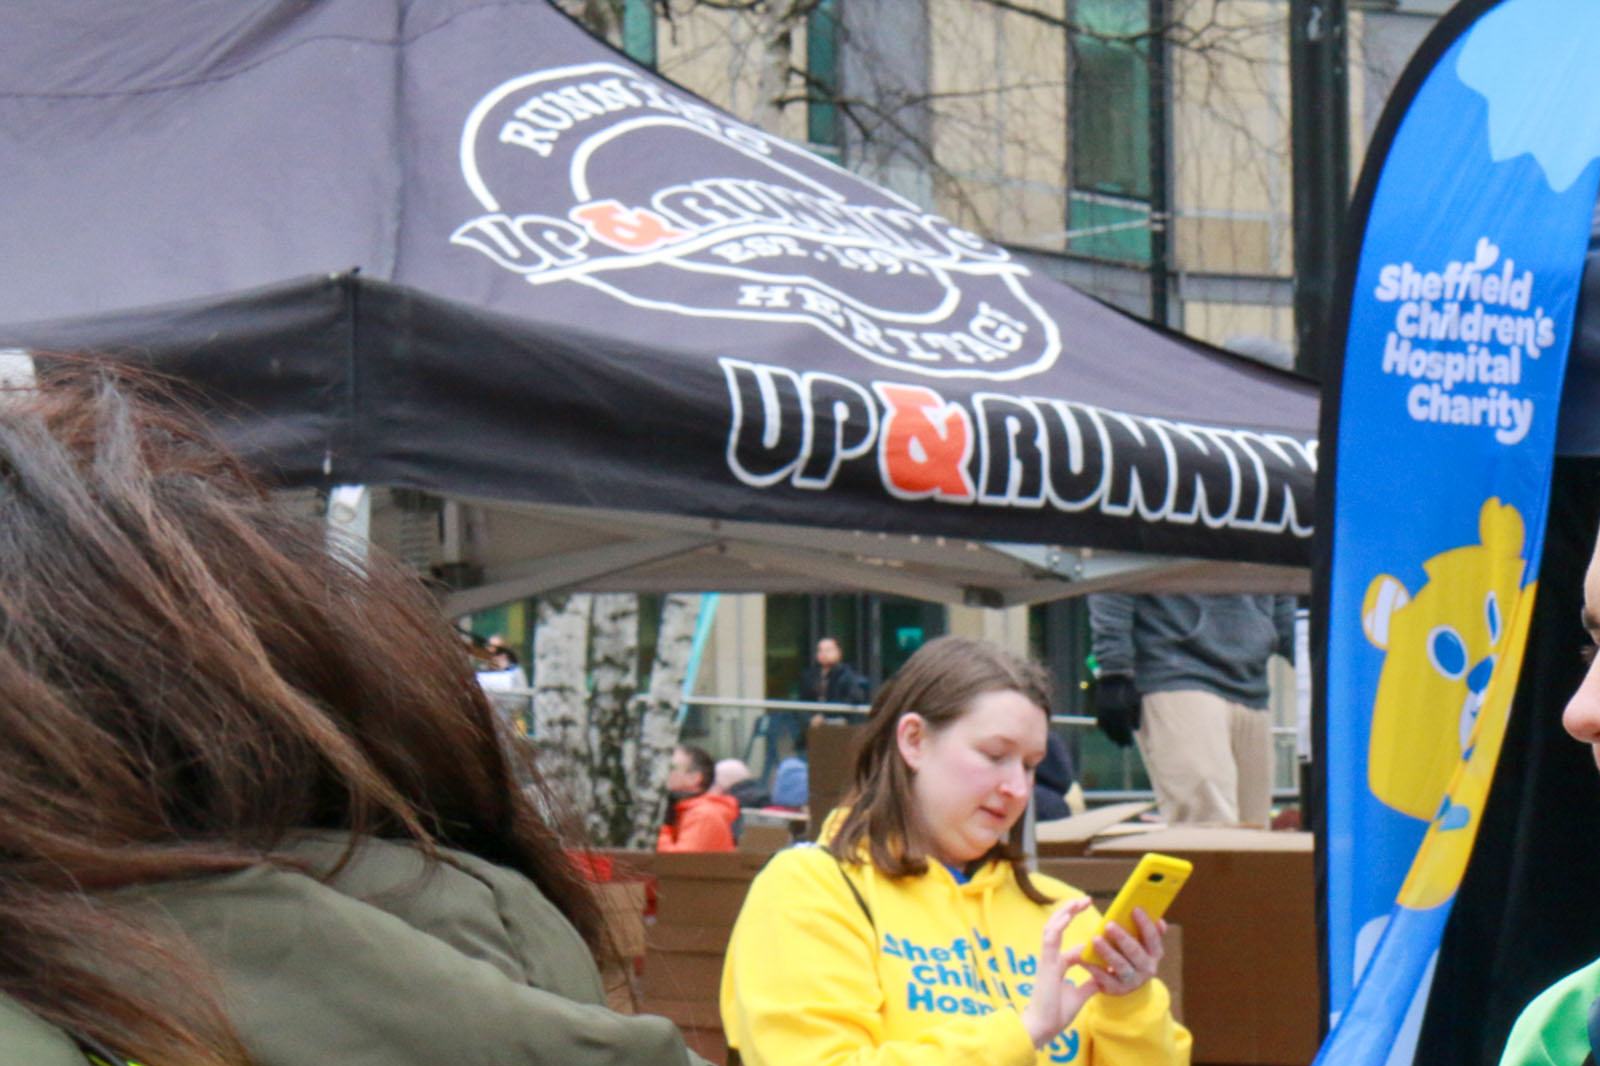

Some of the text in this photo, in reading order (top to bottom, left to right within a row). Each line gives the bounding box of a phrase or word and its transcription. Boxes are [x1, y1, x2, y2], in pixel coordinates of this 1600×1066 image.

[499, 77, 772, 158] RUNNING
[1375, 236, 1534, 312] Sheffield
[1382, 331, 1522, 391] Hospital
[1396, 300, 1556, 360] Children's
[1406, 382, 1535, 446] Charity
